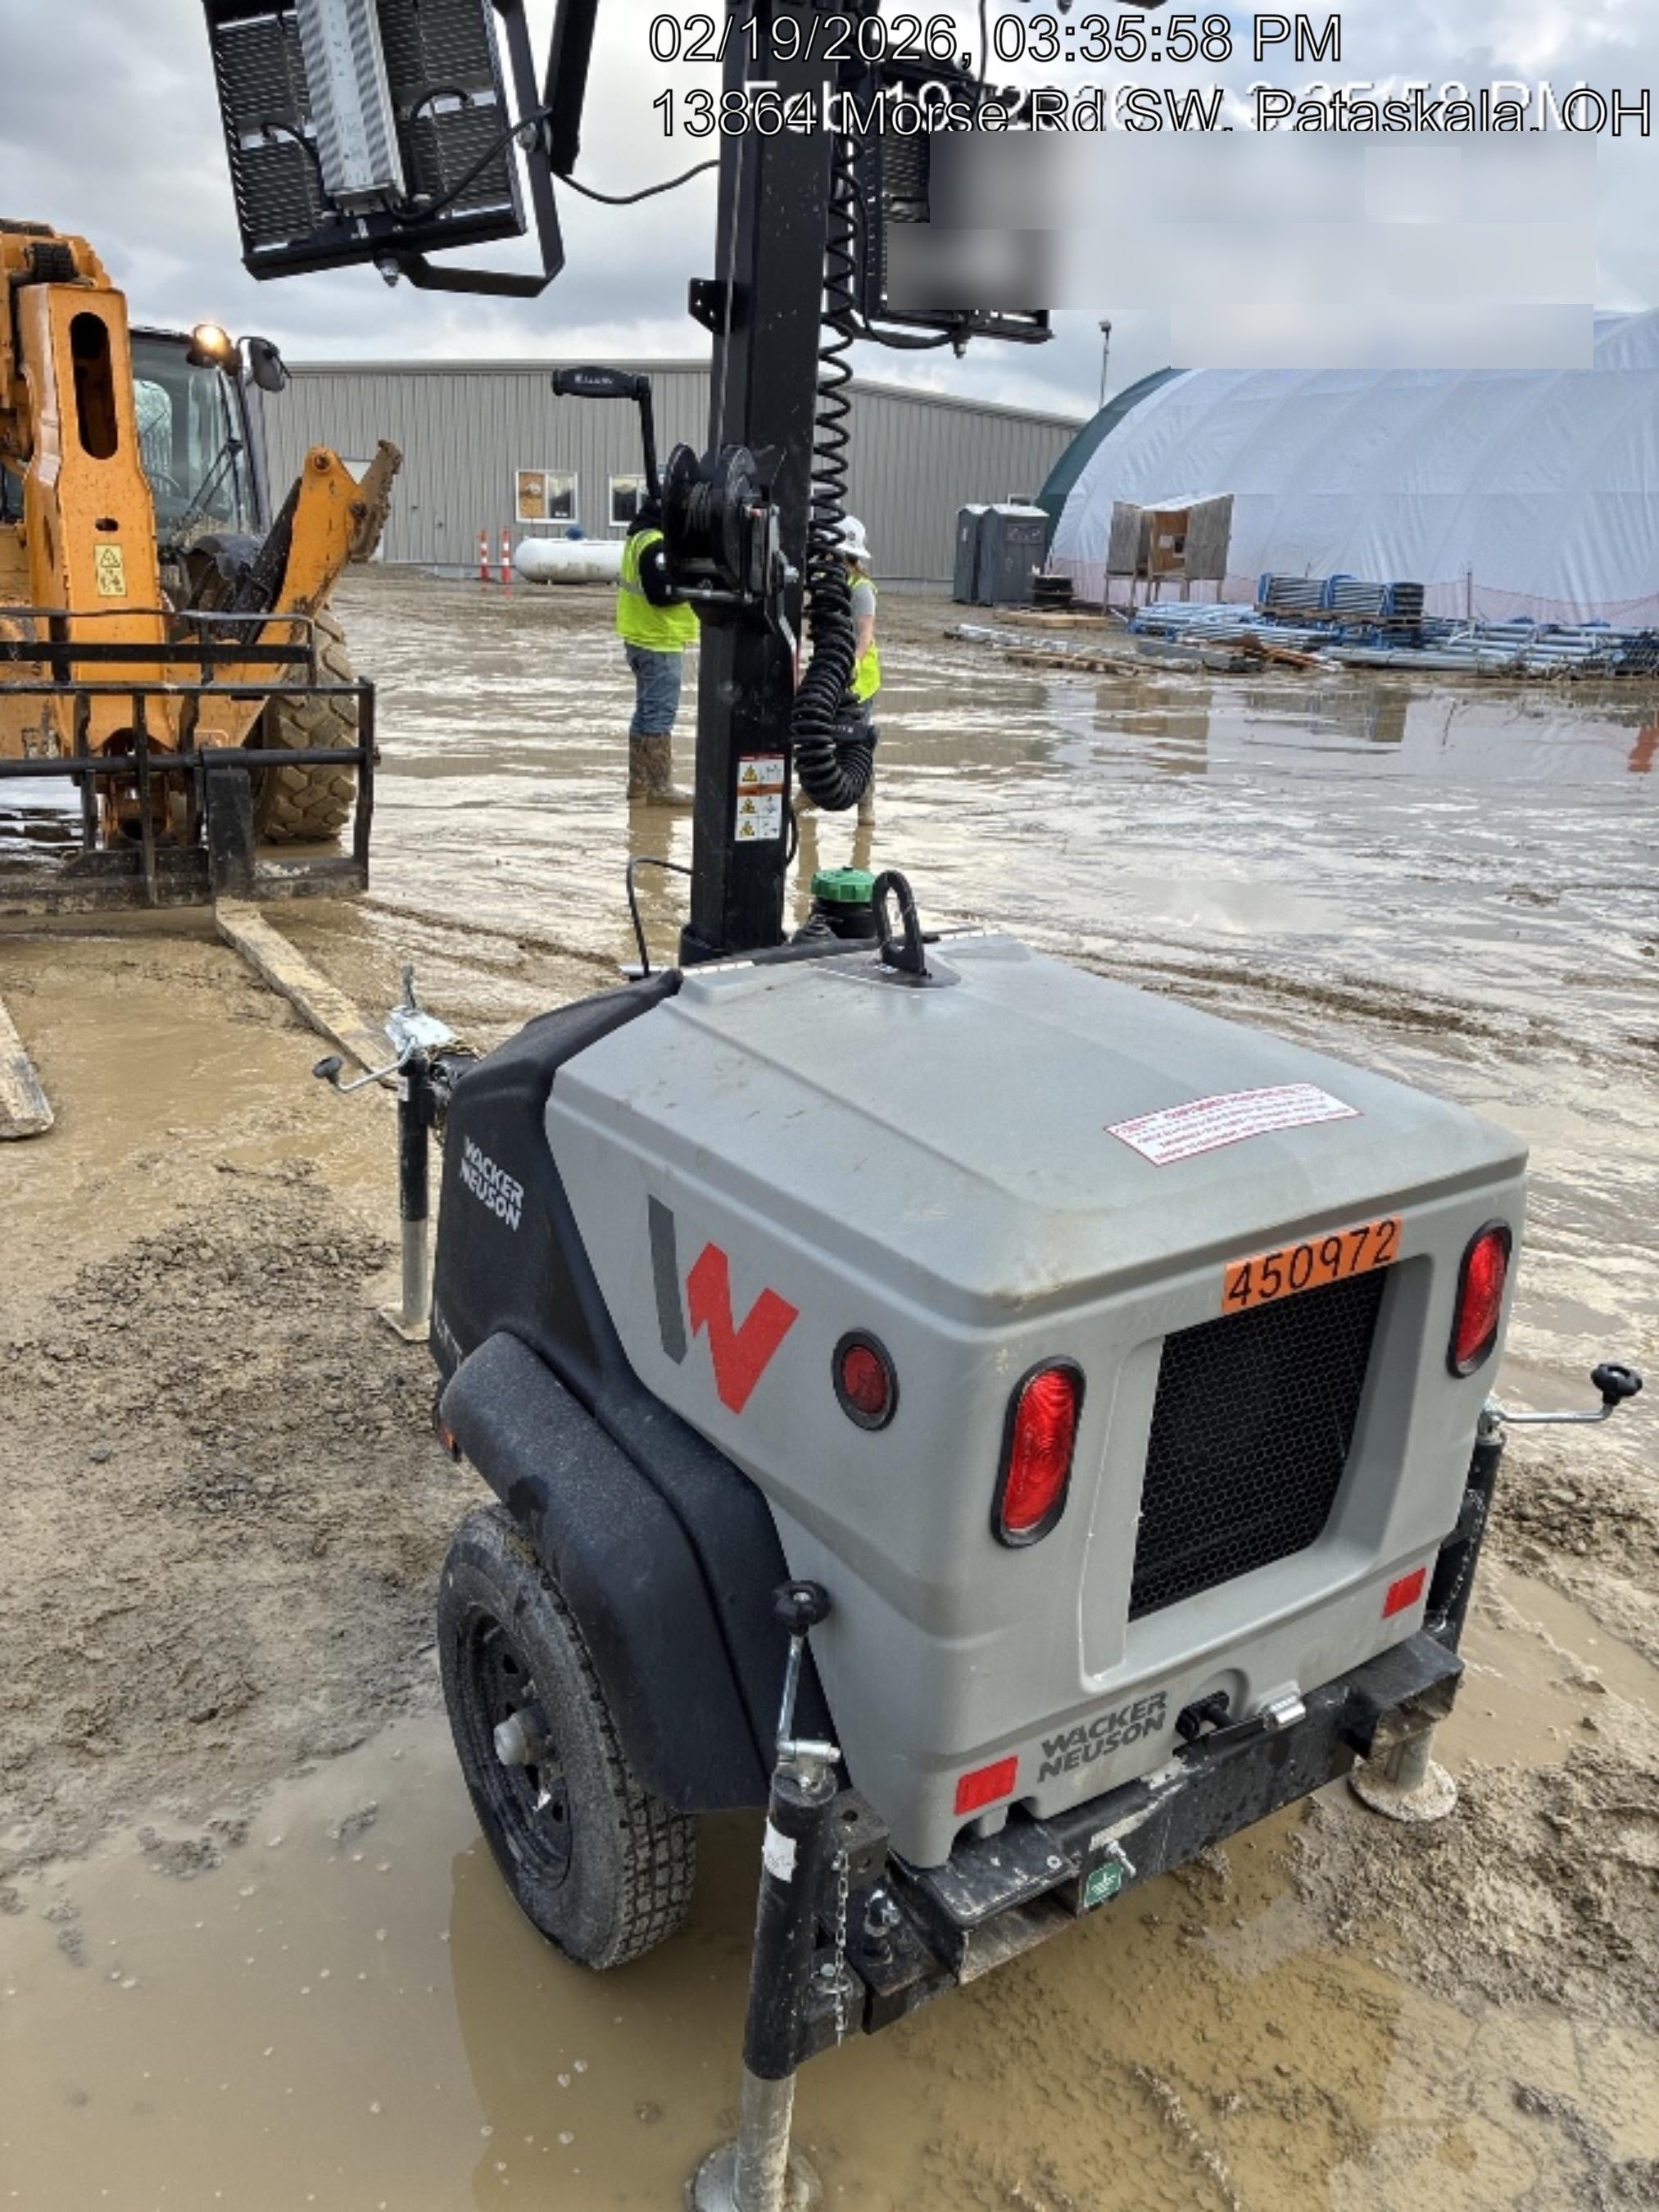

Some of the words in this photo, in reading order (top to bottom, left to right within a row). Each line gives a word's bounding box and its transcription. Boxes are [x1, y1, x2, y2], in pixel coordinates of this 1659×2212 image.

[460, 1158, 522, 1232] NEUSON
[464, 1134, 524, 1208] WACKER
[1228, 1221, 1395, 1305] 450972
[1036, 1710, 1166, 1784] NEUSON
[1041, 1691, 1167, 1758] WACKER
